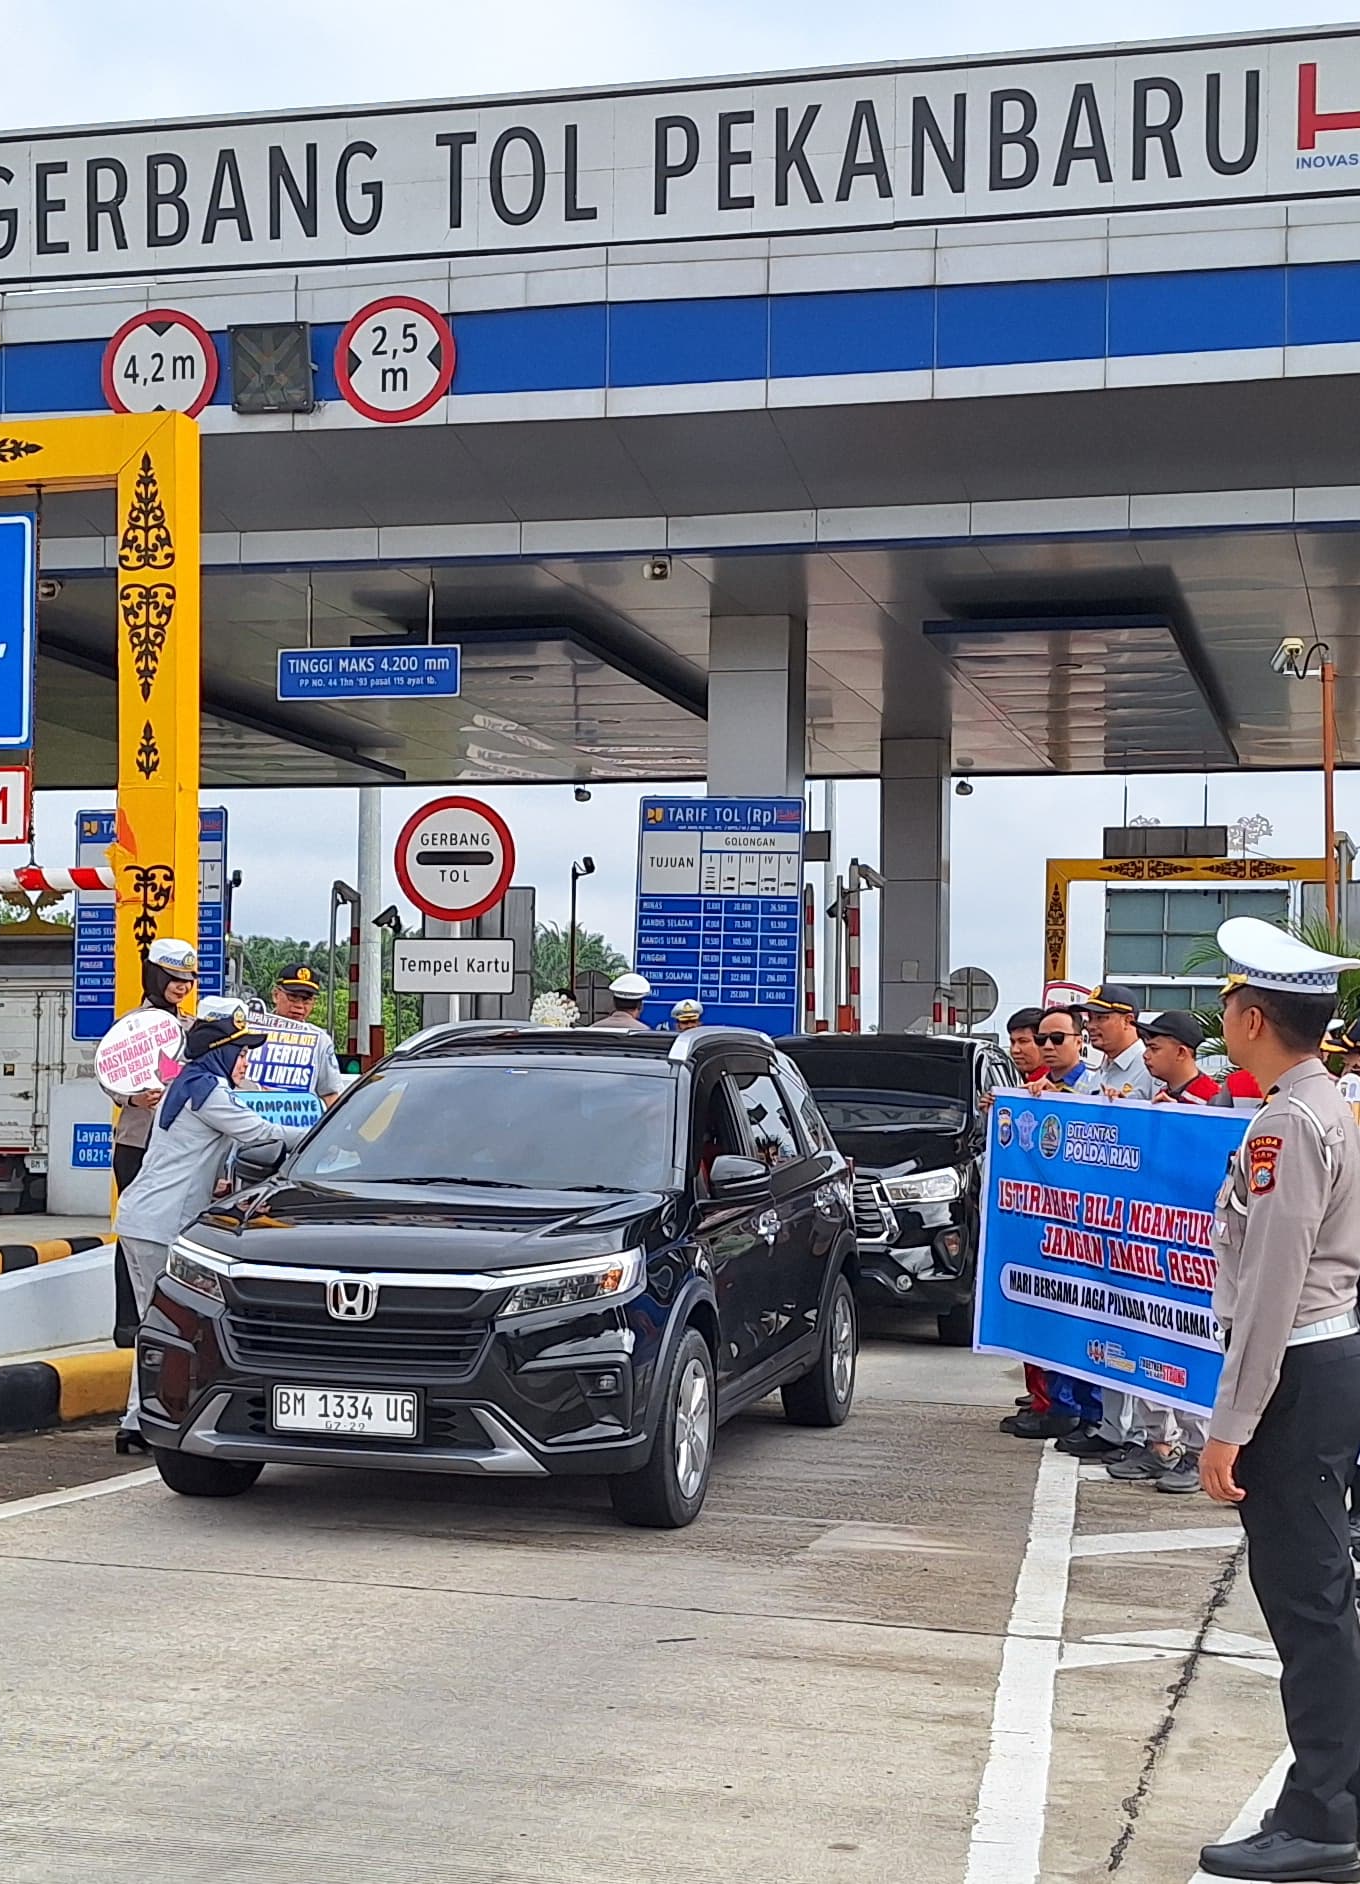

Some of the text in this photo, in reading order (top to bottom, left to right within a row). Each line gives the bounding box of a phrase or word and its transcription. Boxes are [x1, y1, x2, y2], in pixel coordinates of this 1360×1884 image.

[436, 124, 598, 229] TOL
[654, 69, 1260, 215] PEKANBARU
[371, 322, 418, 360] 2,5
[381, 366, 408, 392] m
[288, 656, 450, 673] TINGGI MAKS 4.200 mm
[299, 679, 310, 688] PP
[328, 678, 337, 687] 44
[340, 678, 354, 687] Thn
[370, 677, 390, 689] pasal
[407, 677, 424, 688] ayat
[668, 806, 708, 822] TARIF
[715, 806, 740, 822] TOL
[747, 806, 777, 826] (Rp)
[421, 832, 490, 846] GERBANG
[724, 836, 775, 847] GOLONGAN
[650, 856, 694, 868] TUJUAN
[764, 855, 773, 864] IV
[440, 869, 469, 882] TOL
[400, 956, 510, 976] Tempel Kartu
[98, 1037, 154, 1074] MASYARAKAT
[266, 1044, 313, 1066] TERTIB
[264, 1065, 311, 1086] LINTAS
[246, 1100, 318, 1113] KAMPANYE
[1066, 1122, 1117, 1143] DITLANTAS
[1251, 1137, 1278, 1149] POLDA
[1065, 1142, 1140, 1169] POLDA RIAU
[998, 1179, 1214, 1247] ISTIRAHAT BILA NGANTUK
[1041, 1225, 1104, 1267] JANGAN
[1109, 1240, 1165, 1281] AMBIL
[1009, 1269, 1211, 1339] MARI BERSAMA JAGA PILKADA 2024 DAMAI
[279, 1391, 413, 1423] BM 1334 UG
